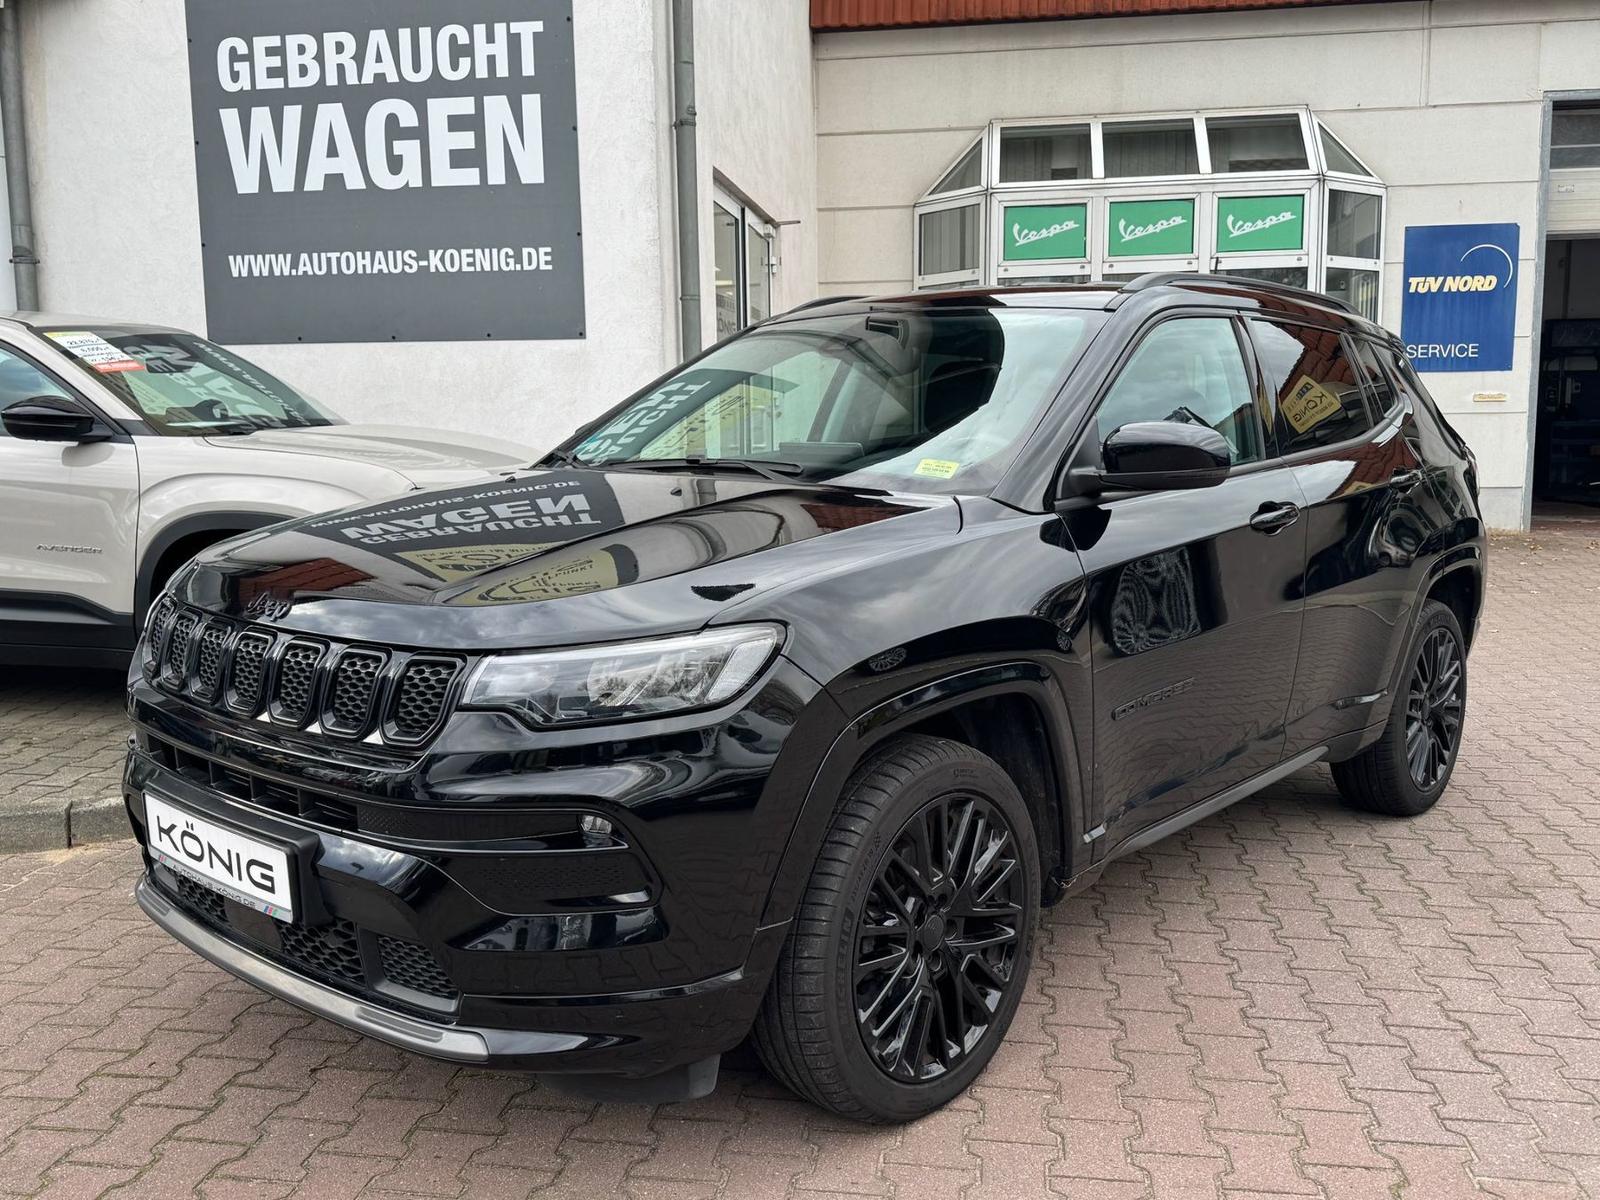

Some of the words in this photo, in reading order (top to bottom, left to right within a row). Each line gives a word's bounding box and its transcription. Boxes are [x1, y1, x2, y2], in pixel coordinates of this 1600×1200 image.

[216, 20, 544, 93] GEBRAUCHT
[218, 93, 545, 194] WAGEN
[1012, 219, 1080, 247] Vespa
[1118, 214, 1187, 242] Vespa
[1226, 211, 1297, 238] Vespa
[228, 246, 553, 278] WWW.AUTOHAUS-KOENIG.DE
[1408, 276, 1444, 294] TÜV
[1442, 274, 1498, 293] NORD
[1406, 343, 1479, 358] SERVICE
[247, 592, 291, 622] Jeep
[156, 815, 276, 895] KÖNIG
